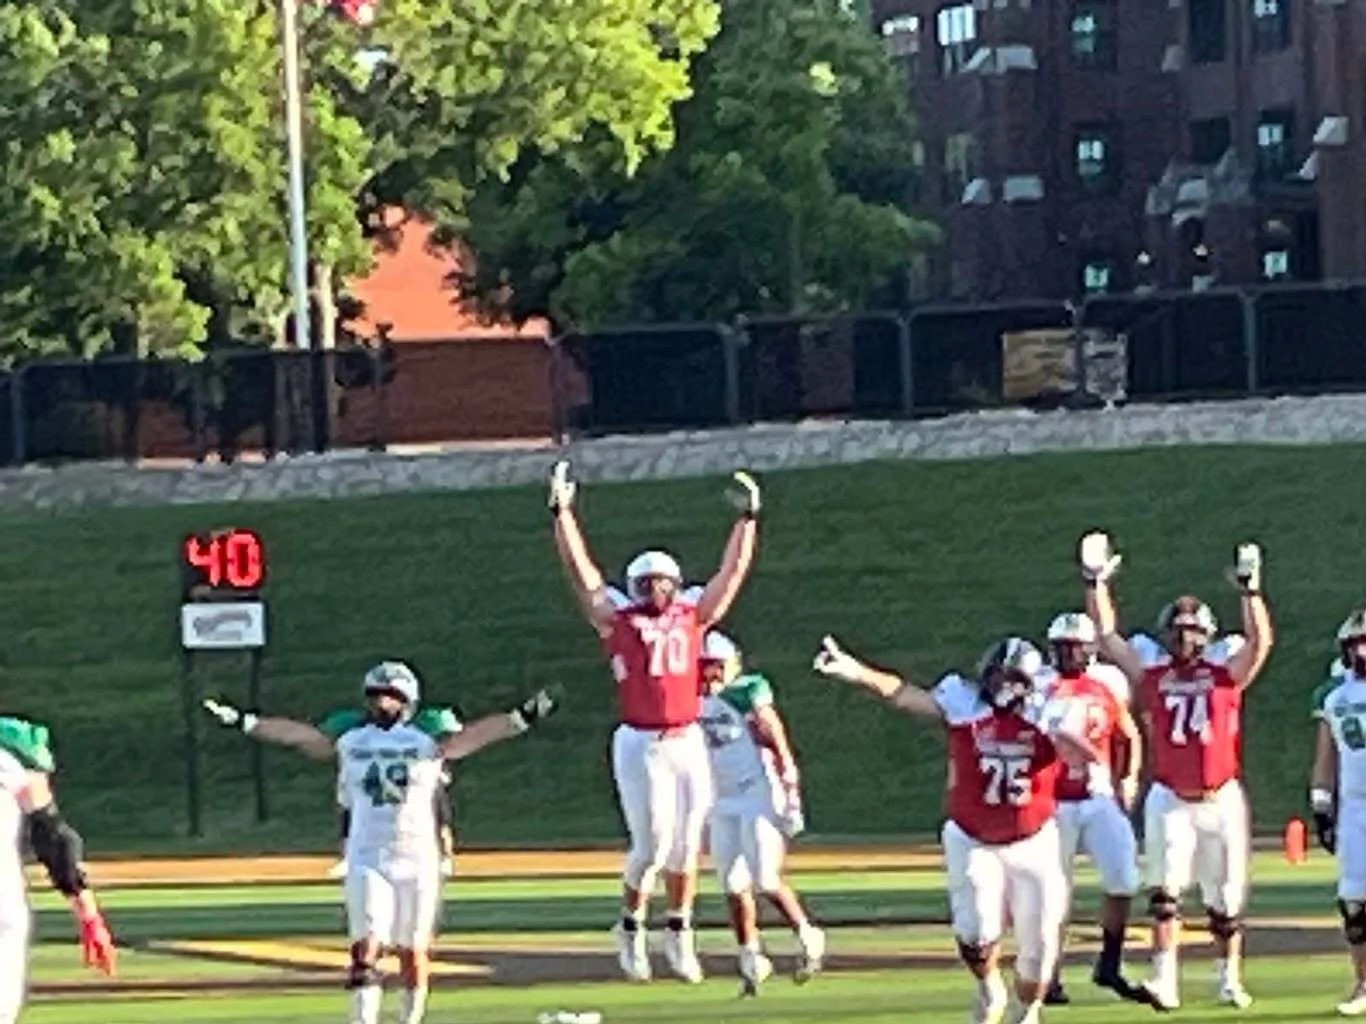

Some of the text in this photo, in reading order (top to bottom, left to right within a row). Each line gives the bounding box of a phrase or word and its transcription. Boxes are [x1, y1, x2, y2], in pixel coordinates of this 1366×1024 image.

[186, 533, 262, 588] 40
[643, 627, 690, 677] 70
[1164, 694, 1214, 745] 74
[979, 756, 1033, 807] 75
